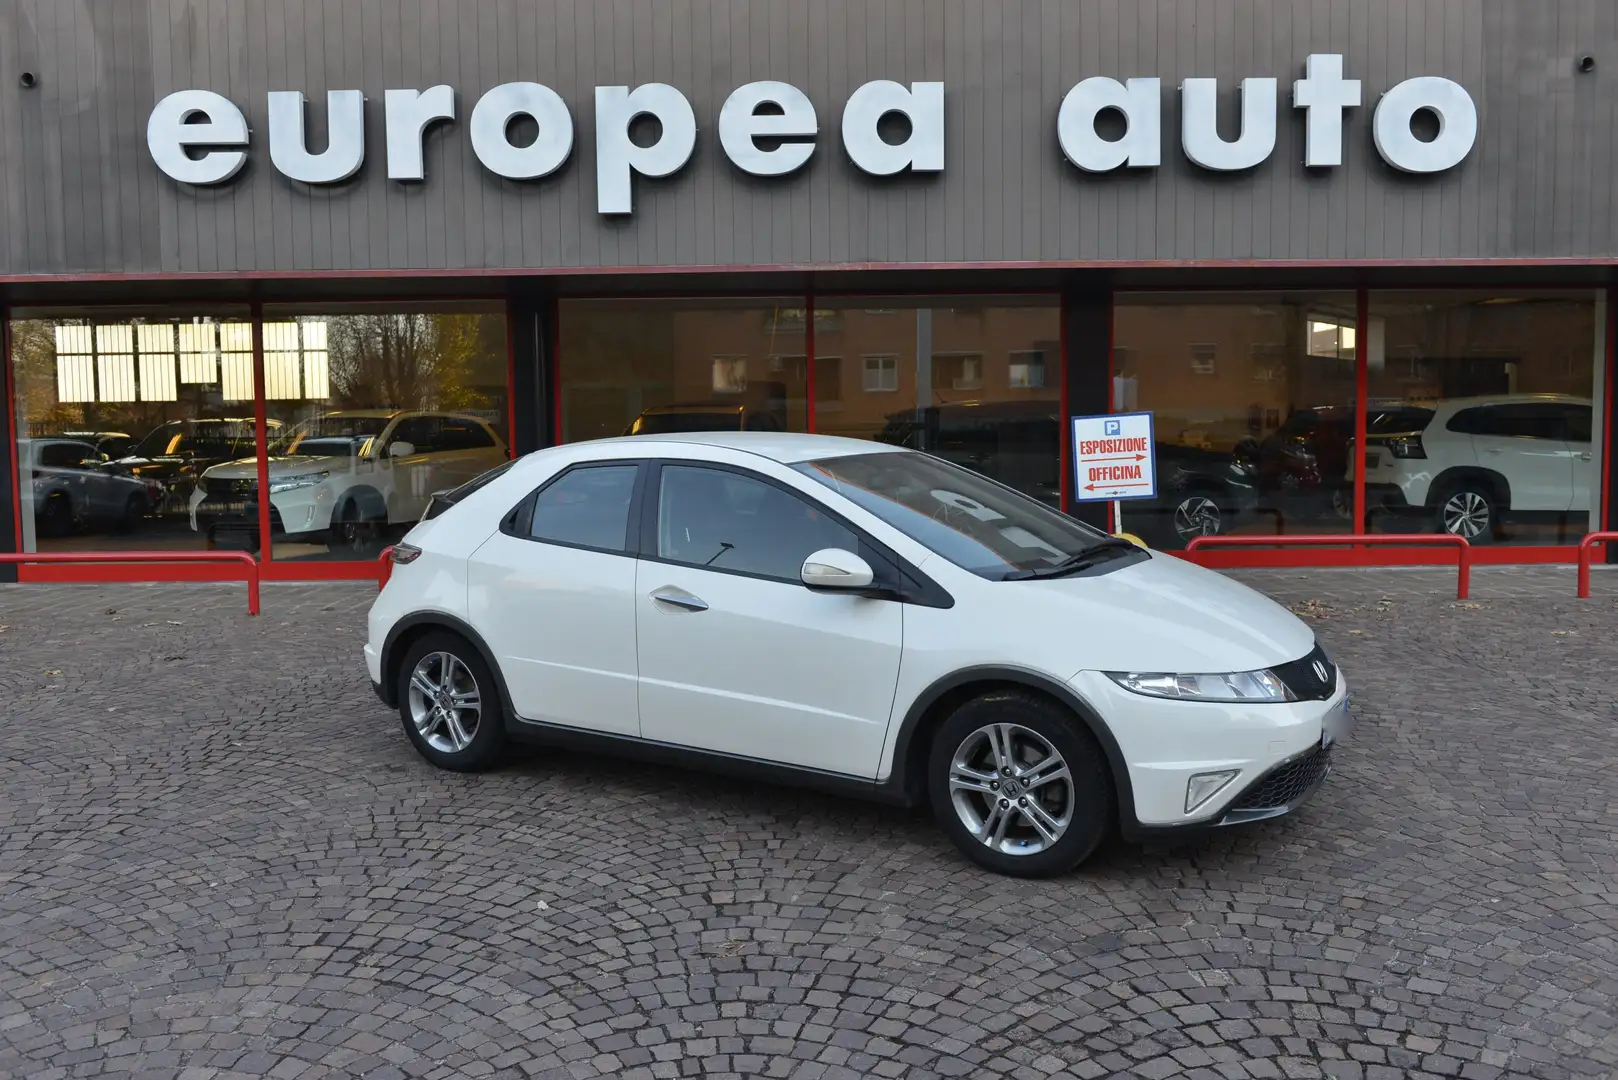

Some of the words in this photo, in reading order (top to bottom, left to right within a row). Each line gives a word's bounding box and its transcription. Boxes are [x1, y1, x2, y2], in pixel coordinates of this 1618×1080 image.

[147, 80, 946, 215] europea
[1057, 53, 1478, 172] auto
[1106, 422, 1118, 434] P
[1080, 437, 1147, 454] ESPOSIZIONE
[1088, 465, 1142, 481] OFFICINA
